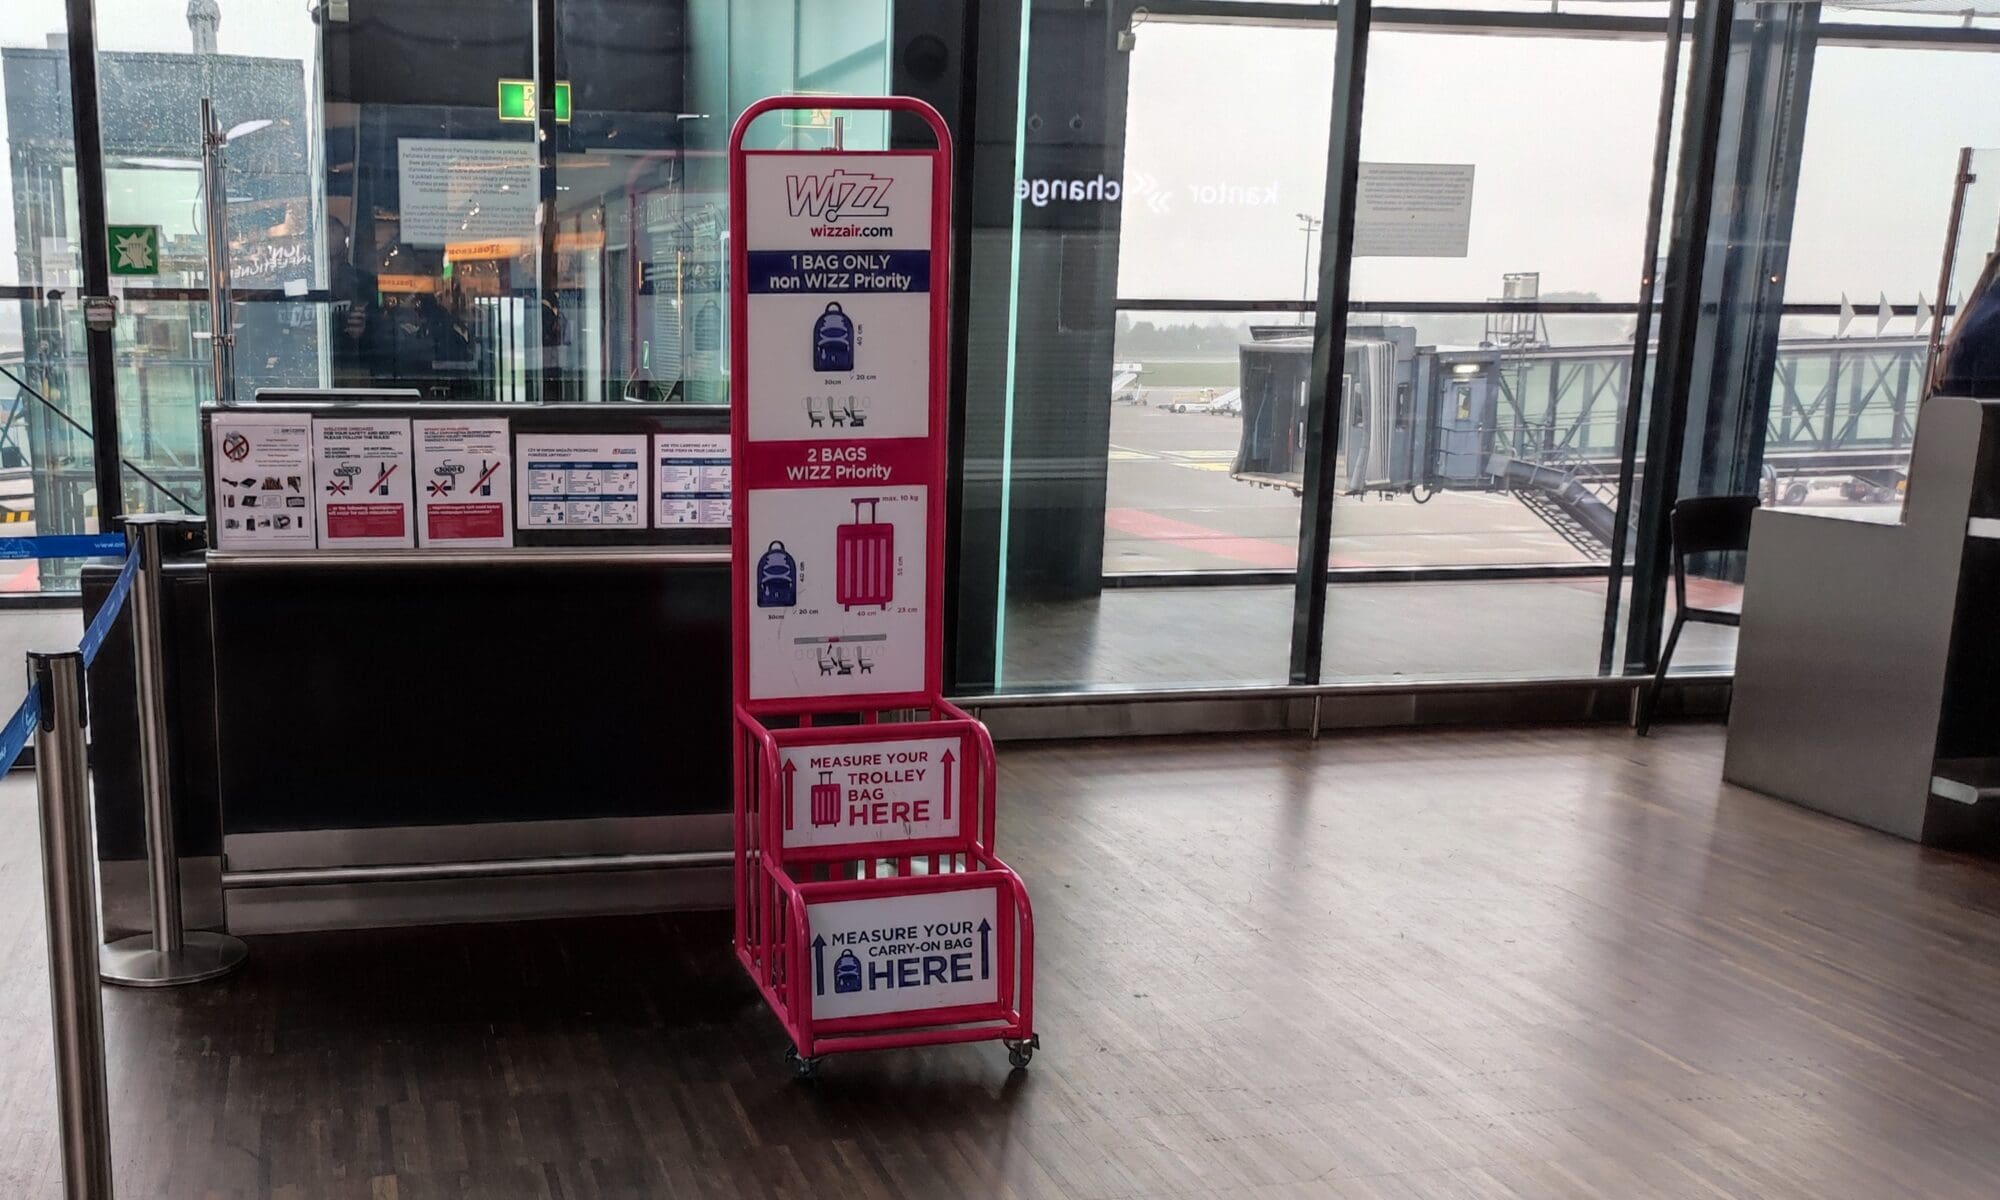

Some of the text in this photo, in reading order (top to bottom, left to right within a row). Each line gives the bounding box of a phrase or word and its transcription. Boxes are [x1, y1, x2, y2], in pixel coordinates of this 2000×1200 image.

[811, 225, 893, 238] wizzair.com
[791, 255, 891, 269] 1 BAG ONLY
[770, 273, 912, 291] non WIZZ Priority
[807, 447, 867, 462] 2 BAGS
[787, 464, 892, 481] WIZZ Priority
[810, 751, 928, 769] MEASURE YOUR
[848, 769, 926, 786] TROLLEY
[848, 788, 884, 802] BAG
[849, 800, 930, 827] HERE
[831, 921, 973, 946] MEASURE YOUR
[868, 937, 973, 957] CARRY-ON BAG
[869, 953, 973, 991] HERE
